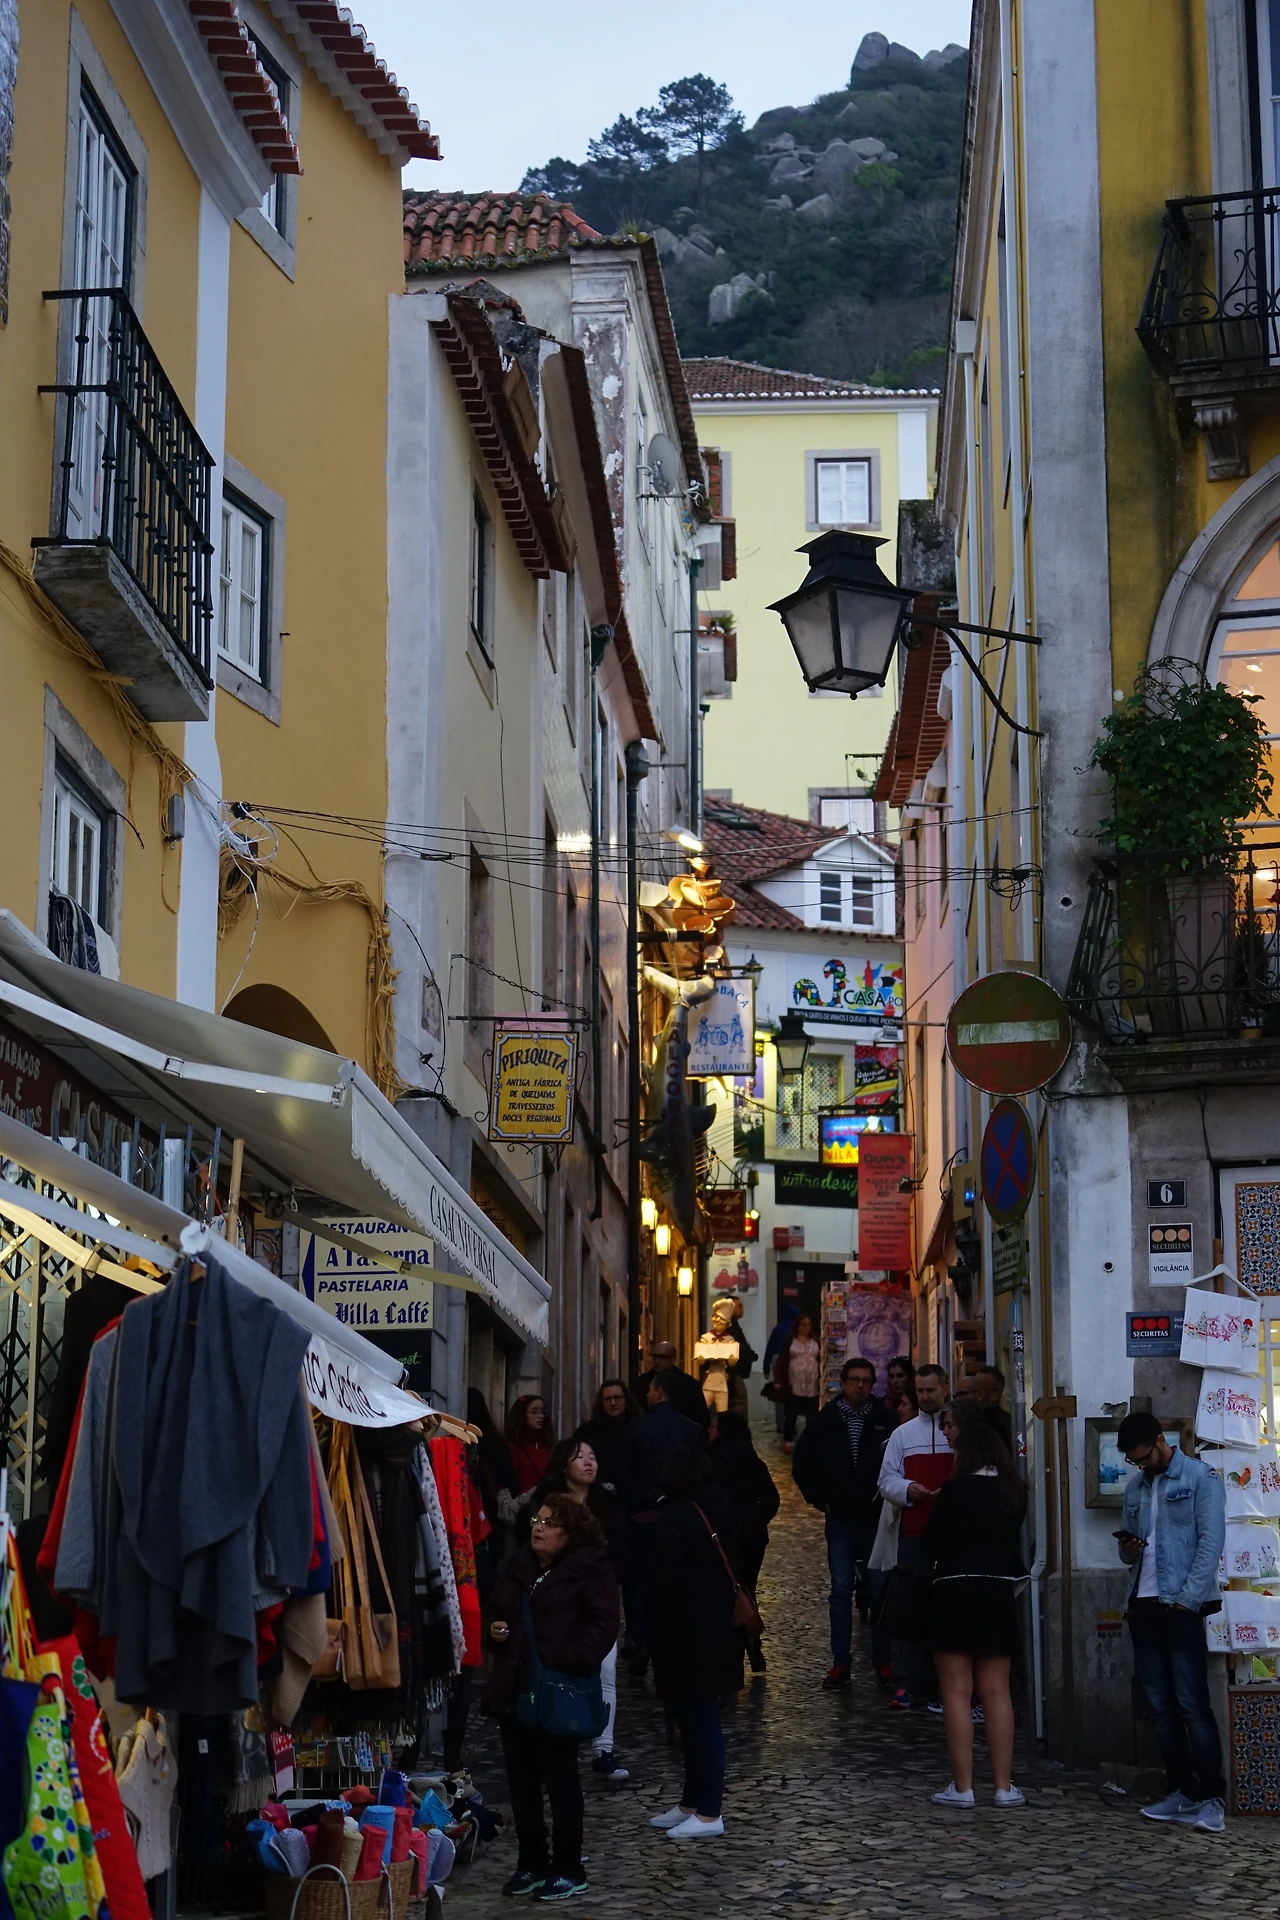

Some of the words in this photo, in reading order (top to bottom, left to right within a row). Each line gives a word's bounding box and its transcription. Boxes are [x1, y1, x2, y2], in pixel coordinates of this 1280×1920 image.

[843, 990, 886, 1007] CASA
[889, 997, 903, 1006] PO
[0, 1034, 40, 1080] TABACOS
[501, 1047, 568, 1075] PIRIQUITA
[691, 1063, 750, 1071] RESTAURANTE
[506, 1078, 530, 1087] ANTIGA
[534, 1078, 562, 1087] FÁBRICA
[15, 1076, 23, 1102] E
[510, 1090, 518, 1098] DE
[521, 1090, 557, 1099] QUEIJADAS
[508, 1102, 555, 1111] TRAVESSEIROS
[502, 1114, 522, 1122] DOCES
[526, 1114, 562, 1123] REGIONAIS
[826, 1150, 854, 1160] VILA
[1160, 1183, 1173, 1204] 6
[1152, 1243, 1190, 1251] SECURITAS
[326, 1248, 338, 1267] A
[1153, 1264, 1190, 1273] VIGILÂNCIA
[318, 1280, 409, 1293] PASTELARIA
[335, 1302, 380, 1325] Villa
[385, 1302, 429, 1324] Caffé
[1133, 1330, 1169, 1338] SECURITAS
[1225, 1400, 1257, 1416] Sintra
